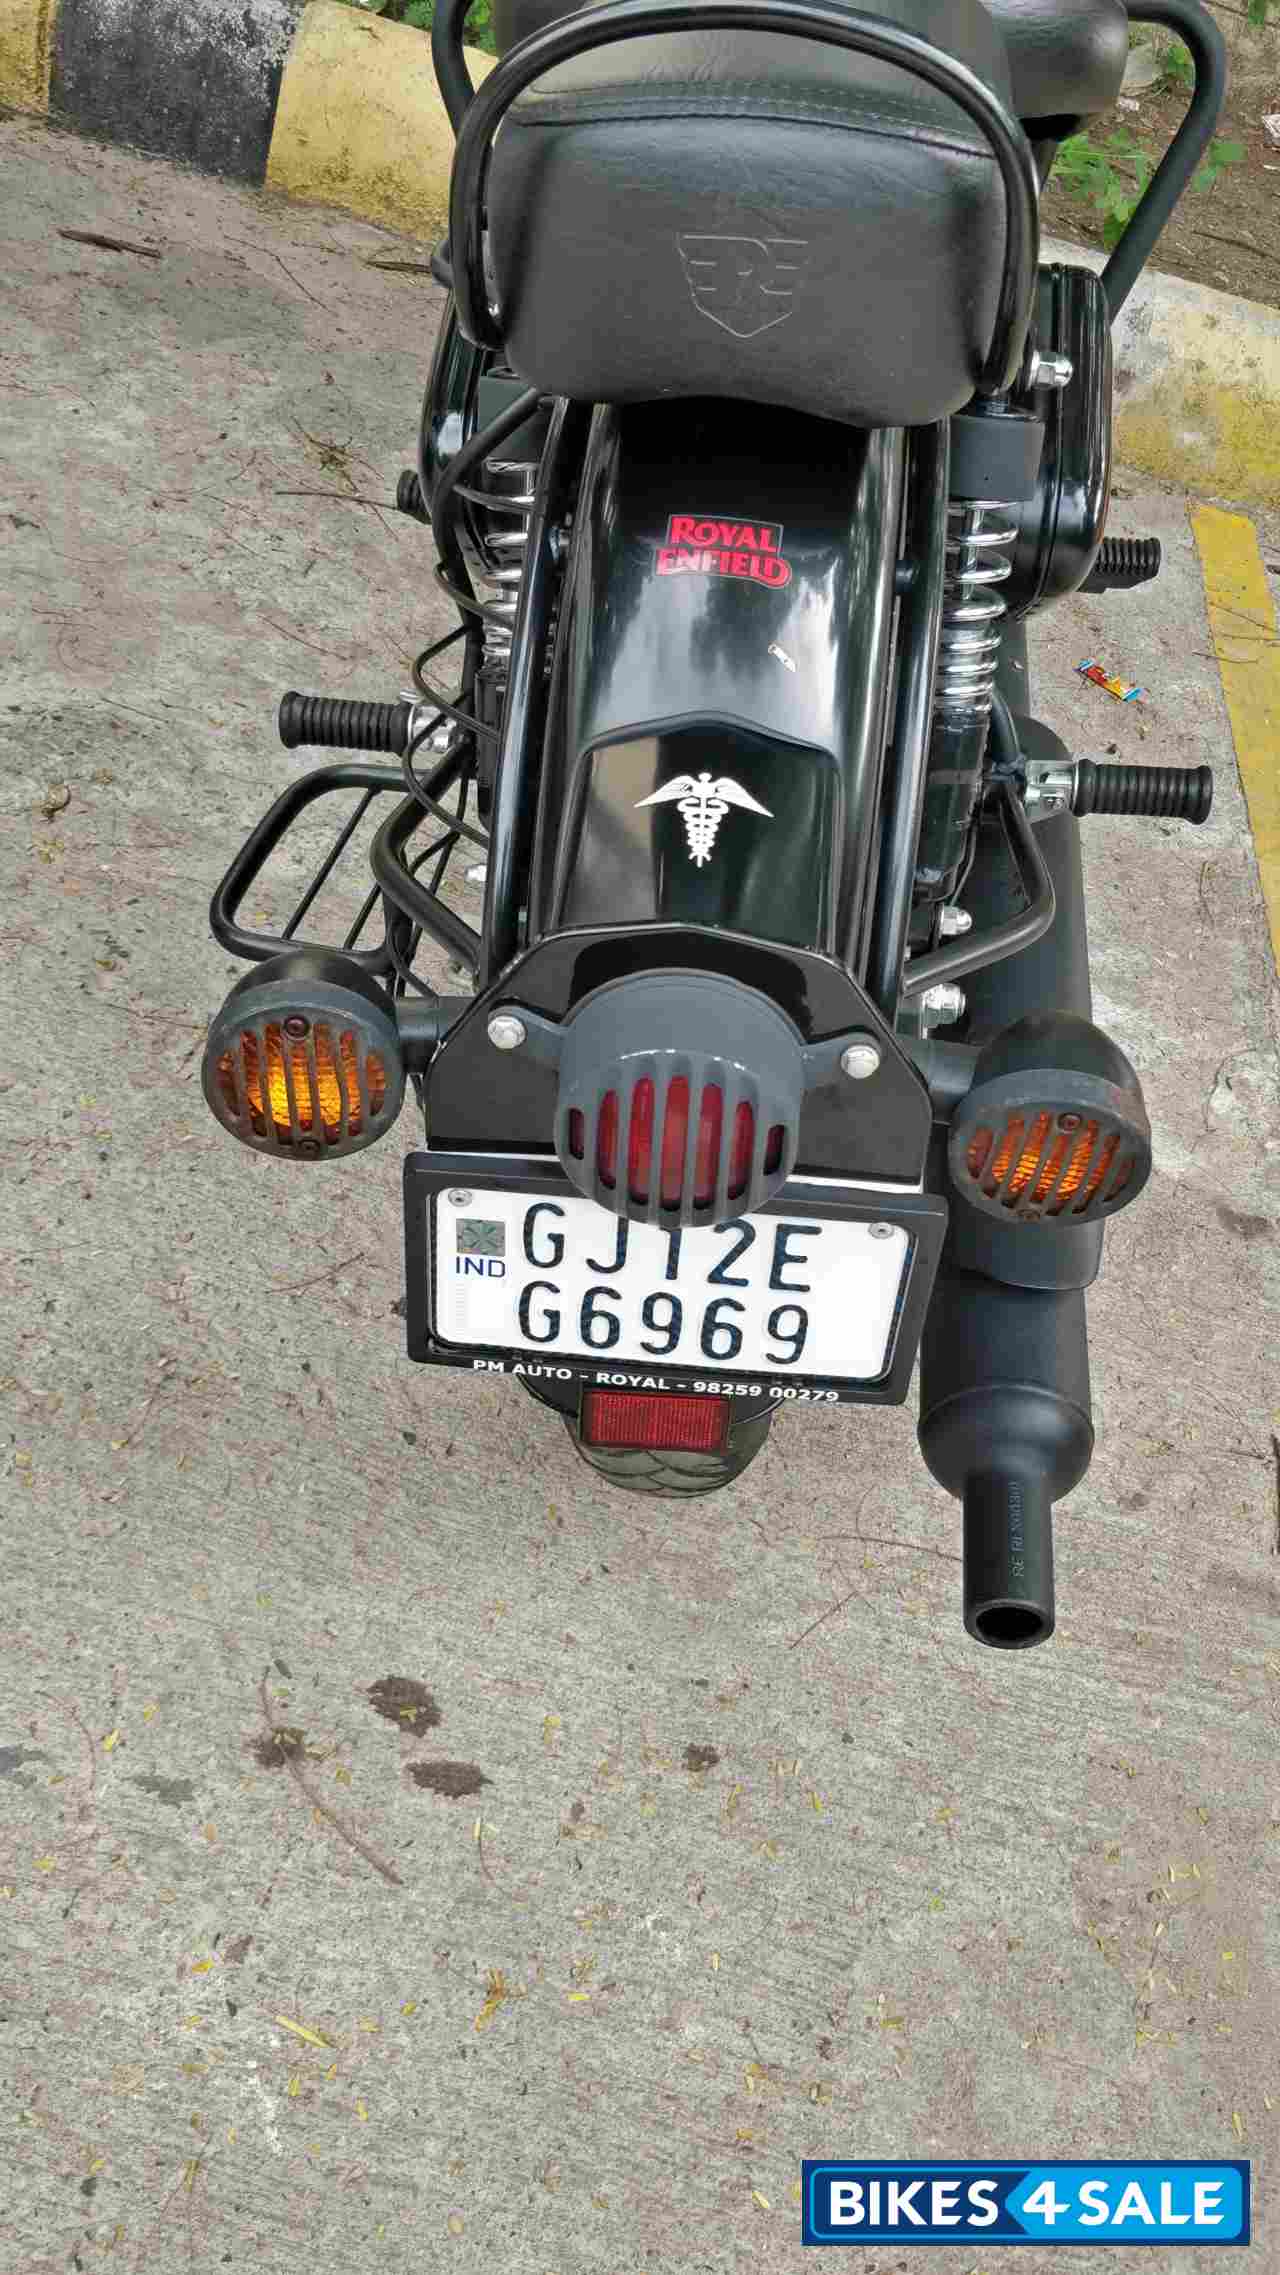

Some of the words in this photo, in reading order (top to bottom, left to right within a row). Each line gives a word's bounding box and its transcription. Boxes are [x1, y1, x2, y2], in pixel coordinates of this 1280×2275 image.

[671, 517, 778, 553] ROYAL
[656, 548, 789, 587] ENFIELD
[455, 1256, 506, 1278] IND
[523, 1202, 823, 1292] GJ12E
[518, 1280, 810, 1364] G6969
[473, 1359, 505, 1374] PM
[512, 1363, 573, 1380] AUTO
[596, 1372, 671, 1390] ROYAL
[693, 1381, 762, 1397] 98259
[769, 1387, 839, 1402] 00279
